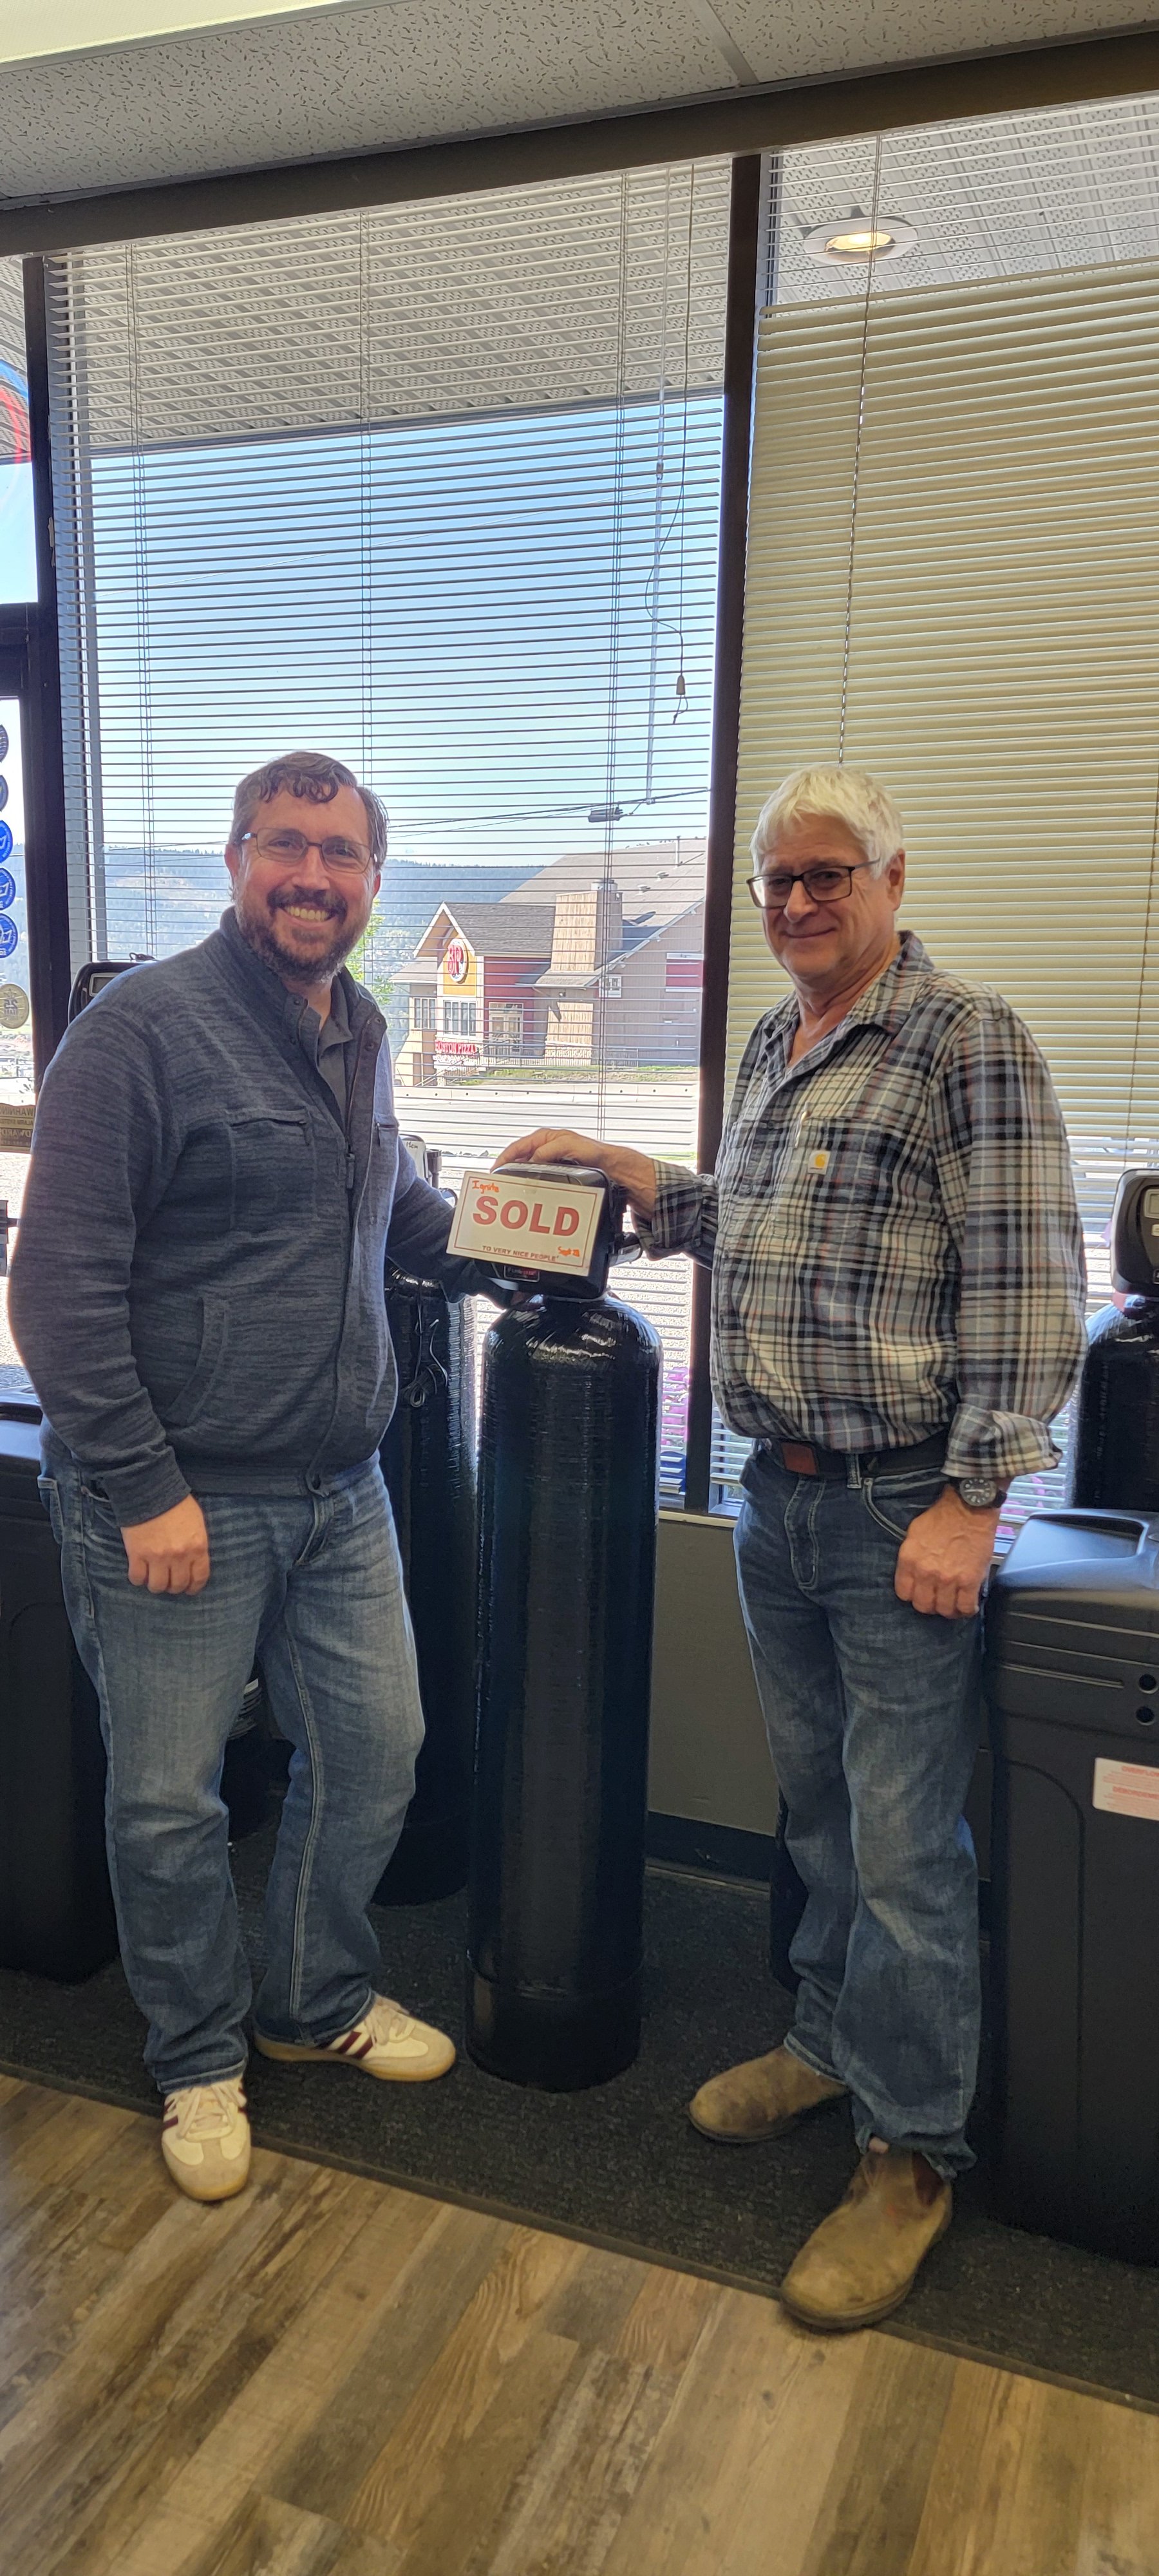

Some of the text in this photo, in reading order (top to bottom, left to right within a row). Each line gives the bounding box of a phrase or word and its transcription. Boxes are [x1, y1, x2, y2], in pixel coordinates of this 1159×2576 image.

[435, 1041, 476, 1054] BOSTON PIZZA
[473, 1196, 580, 1236] SOLD
[493, 1247, 511, 1255] VERY
